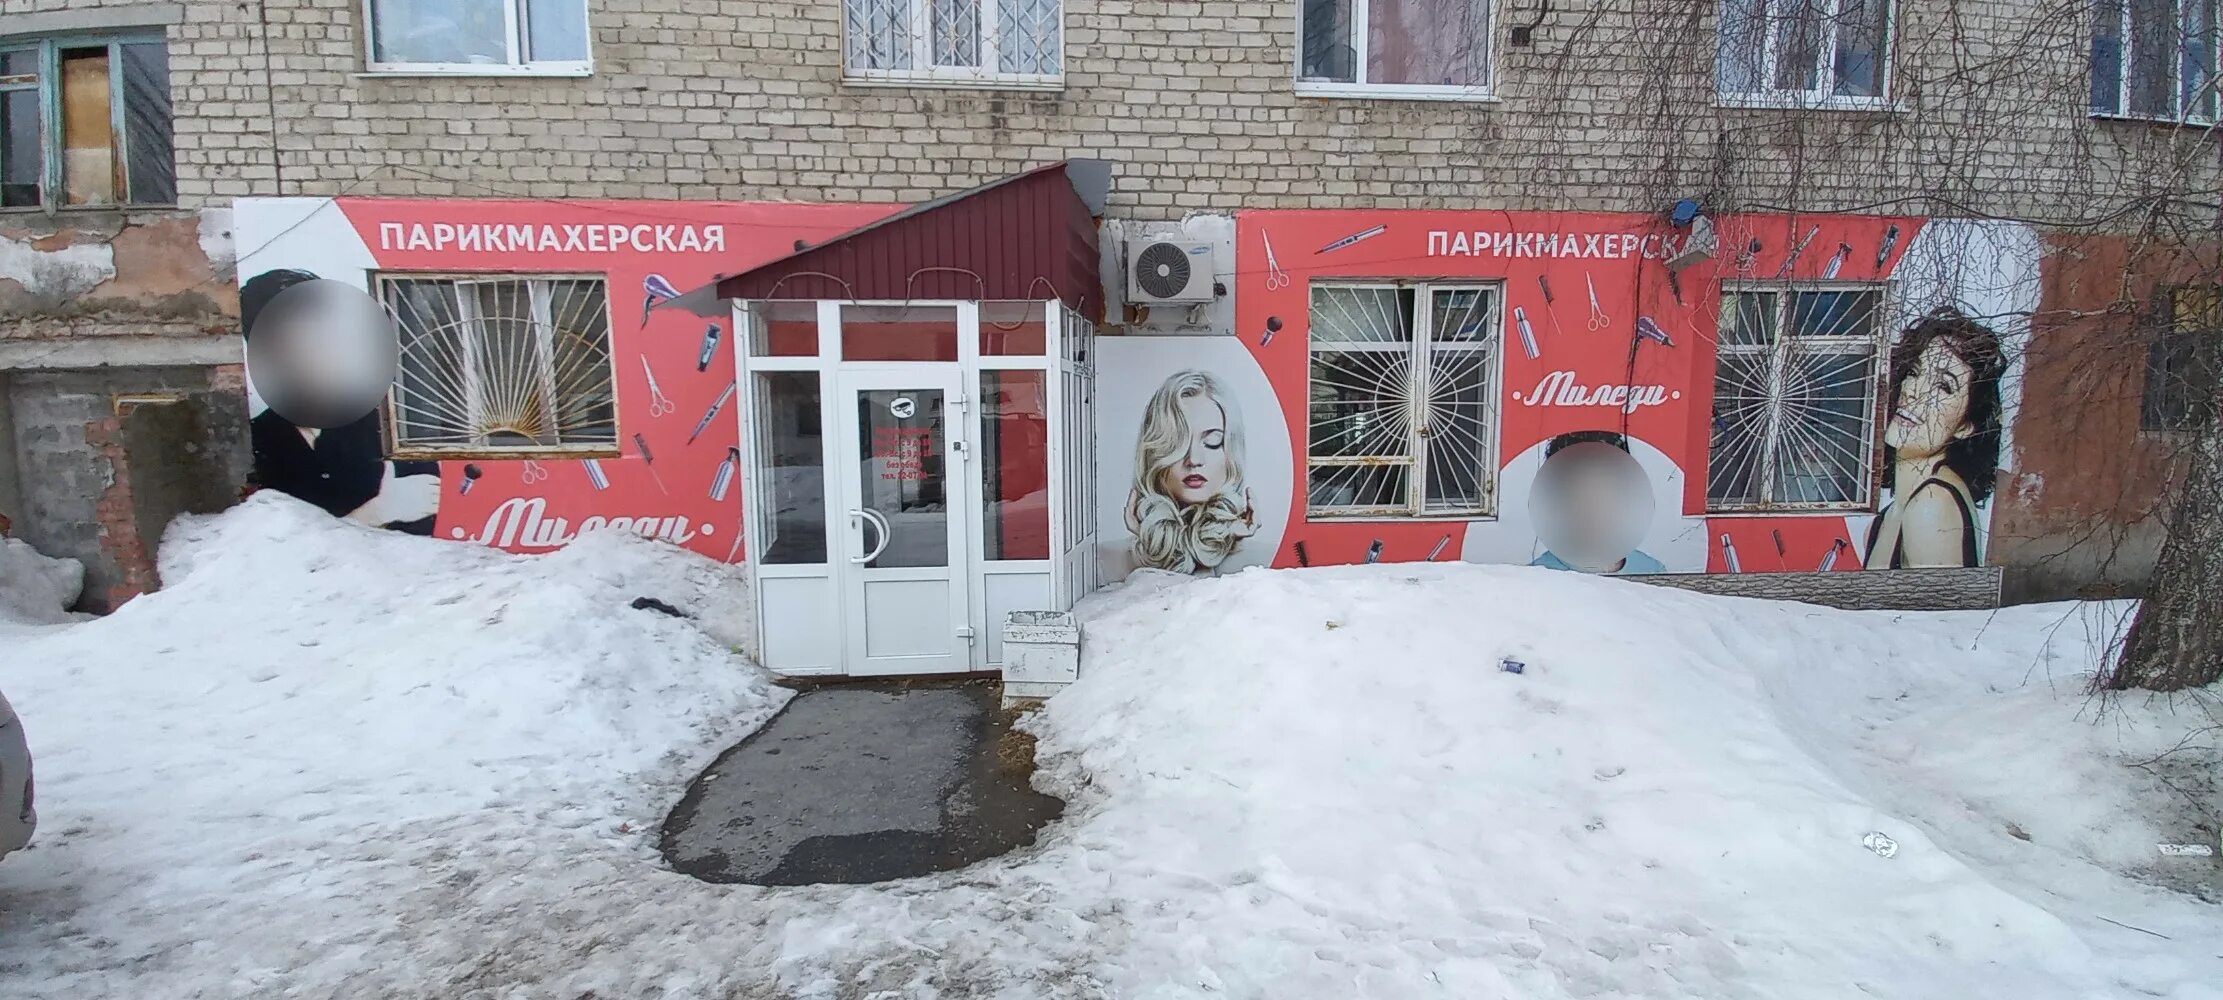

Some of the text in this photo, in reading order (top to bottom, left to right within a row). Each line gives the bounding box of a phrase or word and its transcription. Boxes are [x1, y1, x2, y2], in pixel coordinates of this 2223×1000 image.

[379, 222, 726, 253] ПАРИКМАХЕРСКАЯ
[1427, 230, 1719, 259] ПАРИКМАХЕРСК
[1523, 370, 1669, 415] Миледи
